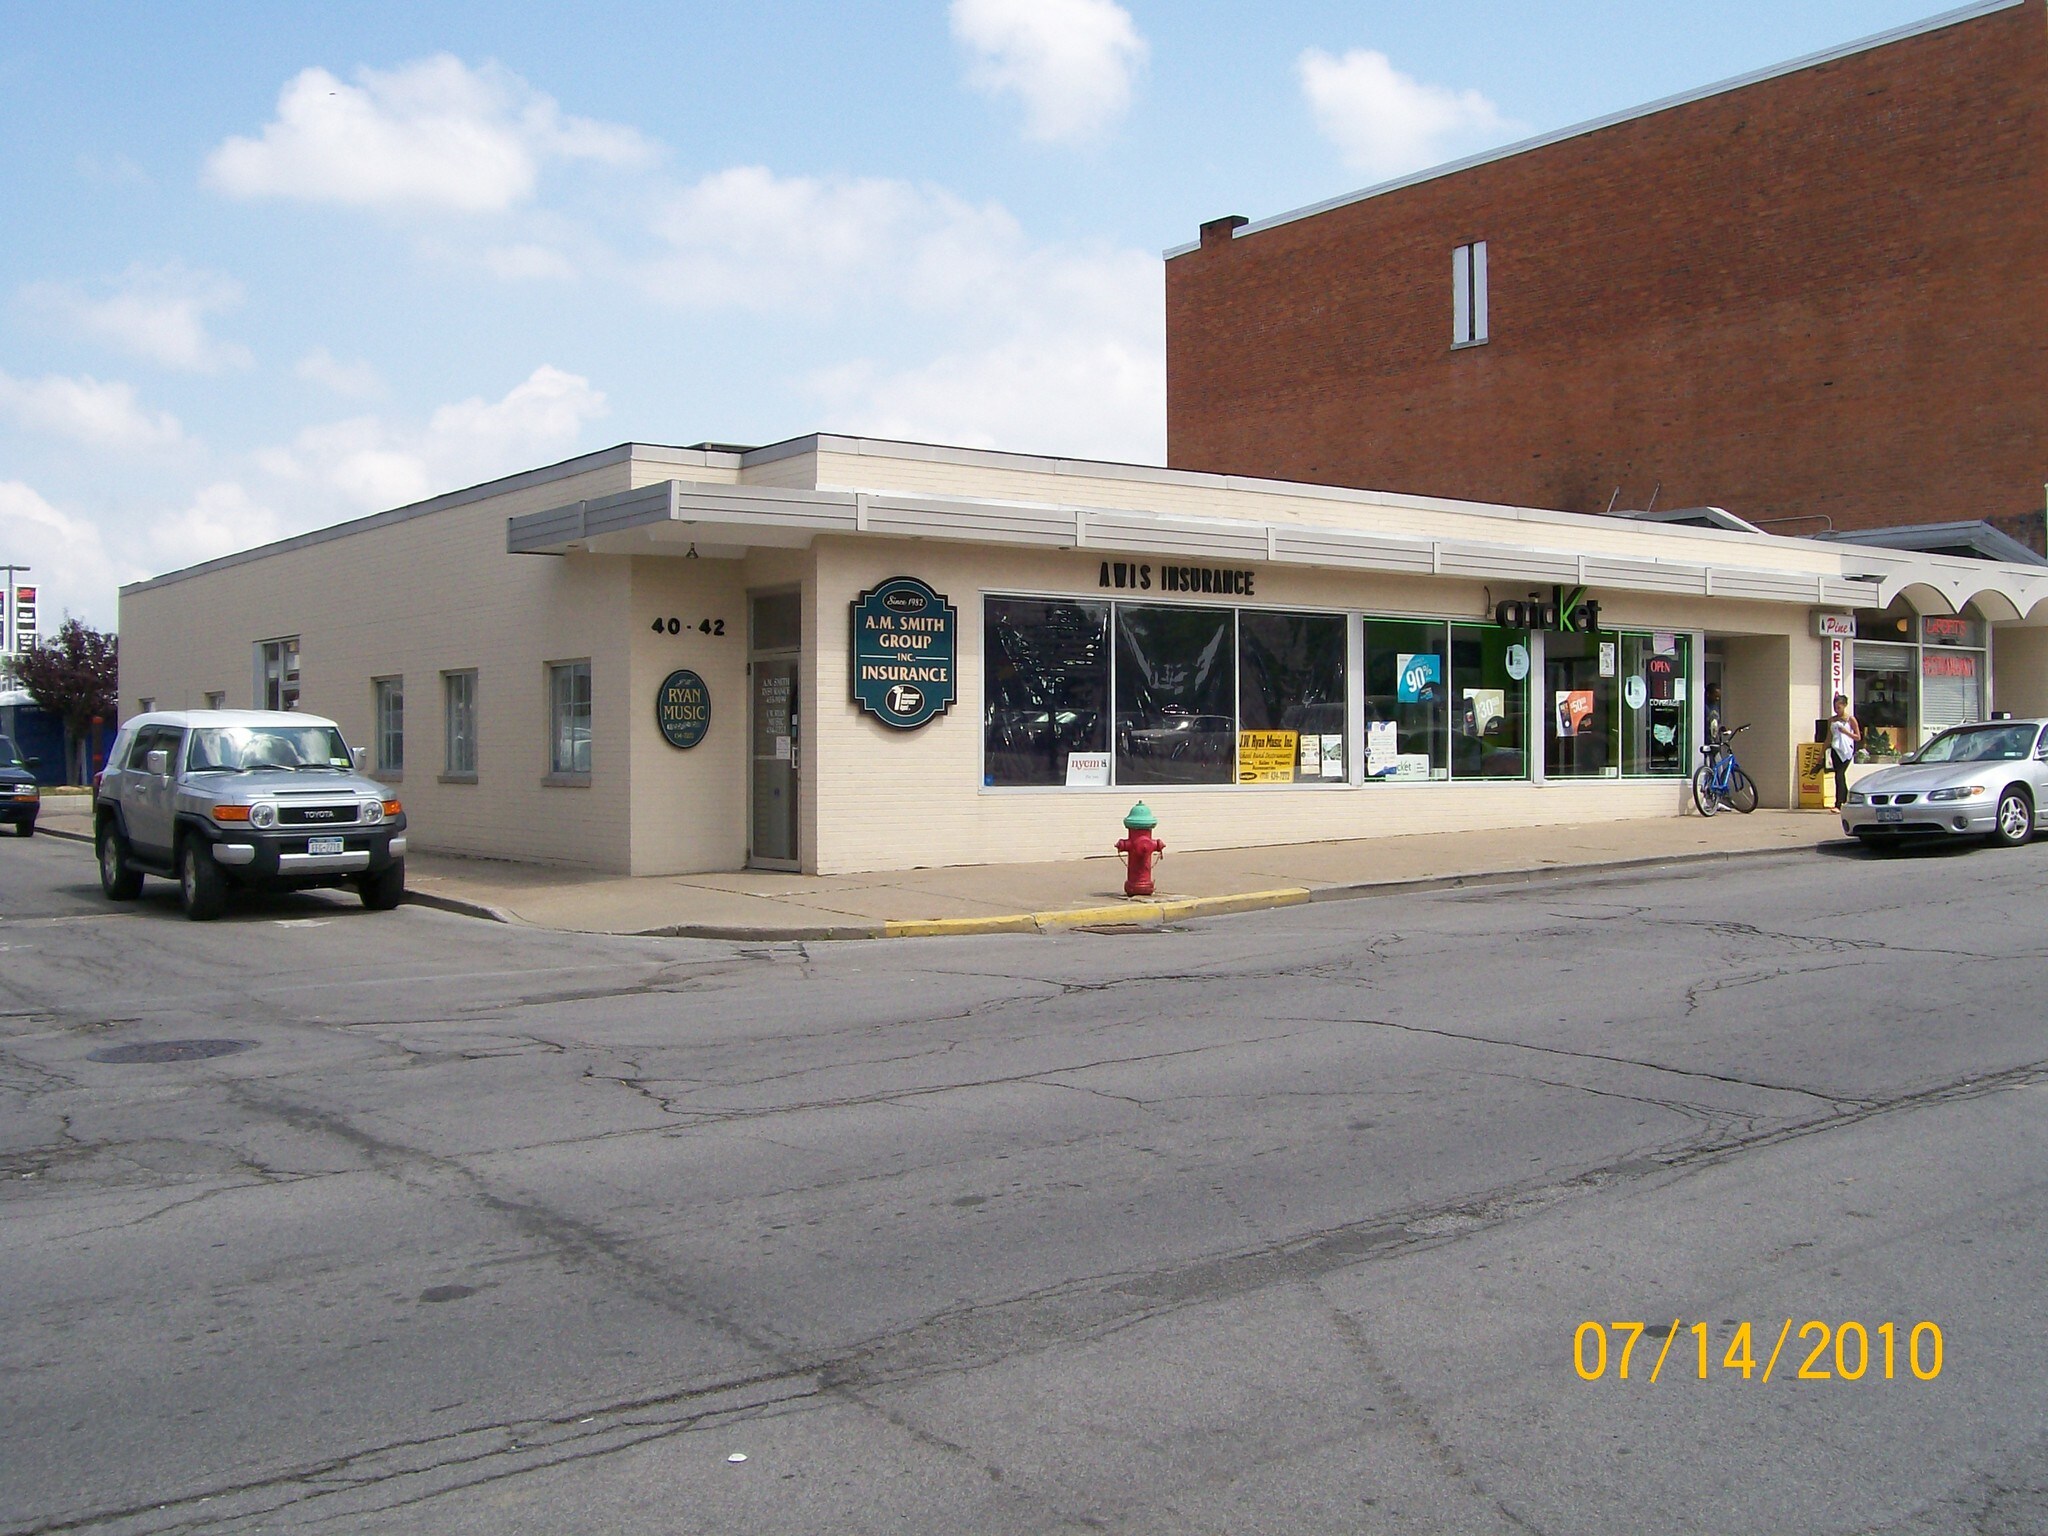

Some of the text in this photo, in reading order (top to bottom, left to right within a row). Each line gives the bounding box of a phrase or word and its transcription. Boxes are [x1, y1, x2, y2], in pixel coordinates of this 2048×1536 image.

[1161, 566, 1255, 596] INSURANCE
[887, 595, 906, 607] Since
[865, 615, 945, 632] A.M. SMITH
[1826, 617, 1848, 635] Pine
[879, 633, 932, 649] GROUP
[897, 652, 917, 662] INC.
[862, 665, 949, 682] INSURANCE
[1650, 659, 1671, 673] OPEN
[668, 689, 701, 703] RYAN
[664, 705, 705, 720] MUSIC
[1251, 734, 1265, 750] Ryan
[304, 810, 334, 818] TOYOTA
